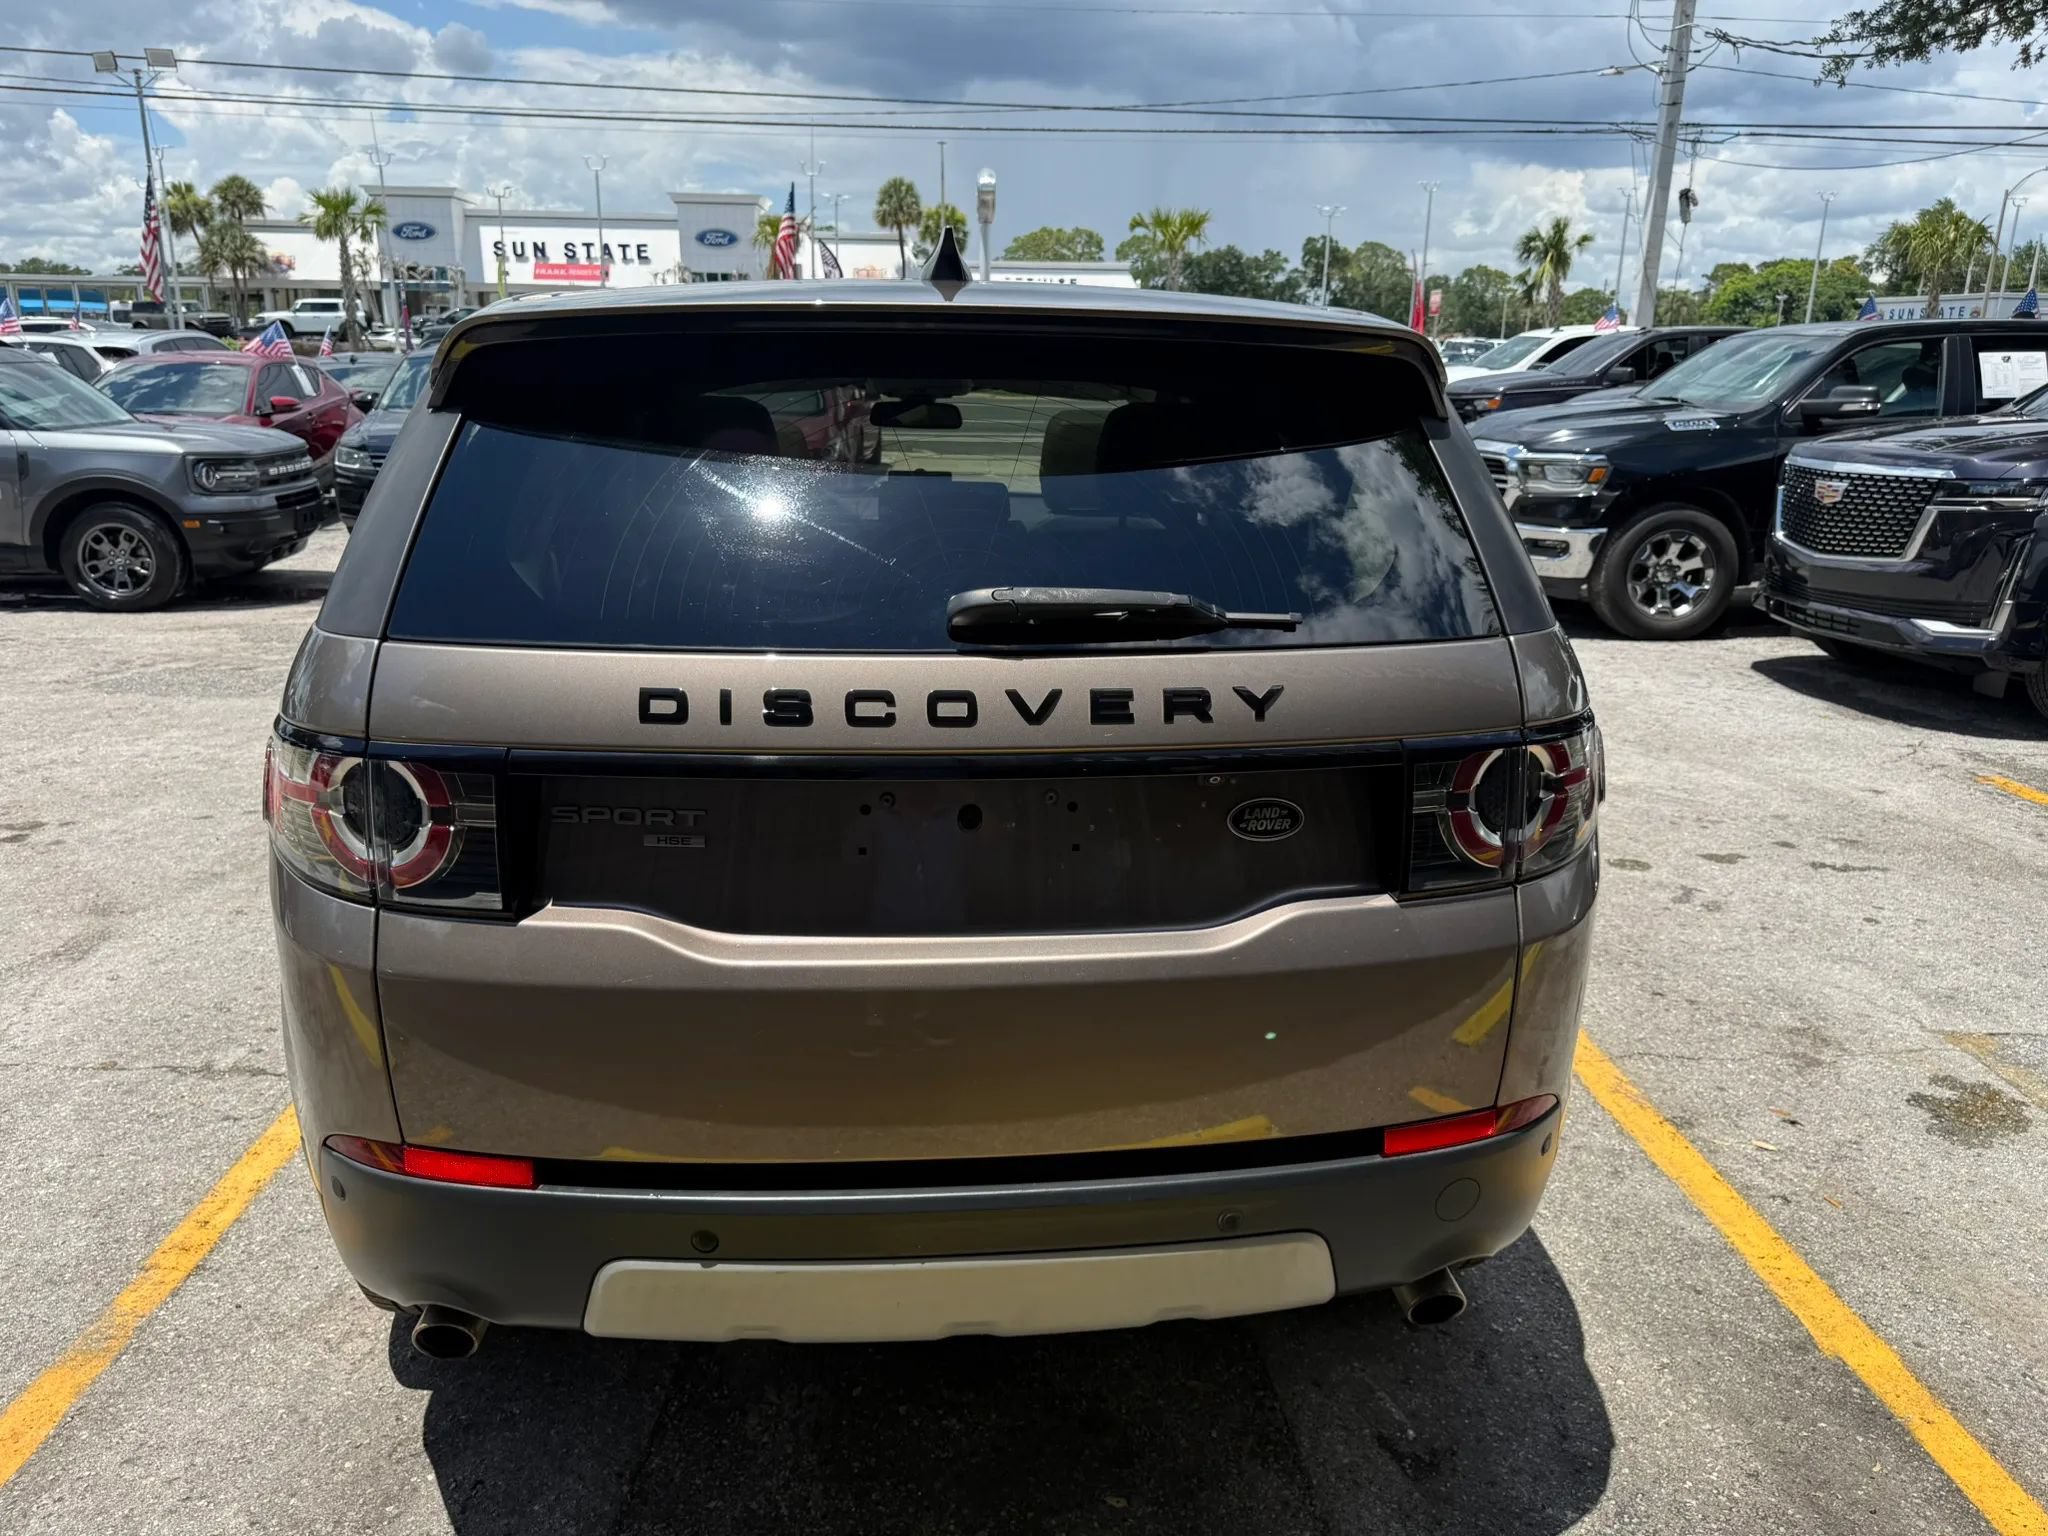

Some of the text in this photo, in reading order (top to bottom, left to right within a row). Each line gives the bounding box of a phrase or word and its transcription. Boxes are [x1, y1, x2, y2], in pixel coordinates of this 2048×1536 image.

[400, 225, 428, 238] Ford
[703, 232, 731, 245] Ford
[493, 241, 649, 260] SUN STATE
[1888, 306, 1966, 319] SUN SATE
[638, 685, 1285, 728] DISCOVERY
[551, 806, 707, 826] SPORT
[1244, 807, 1281, 819] LAND
[1247, 818, 1292, 831] ROVER
[656, 836, 692, 846] HSE
